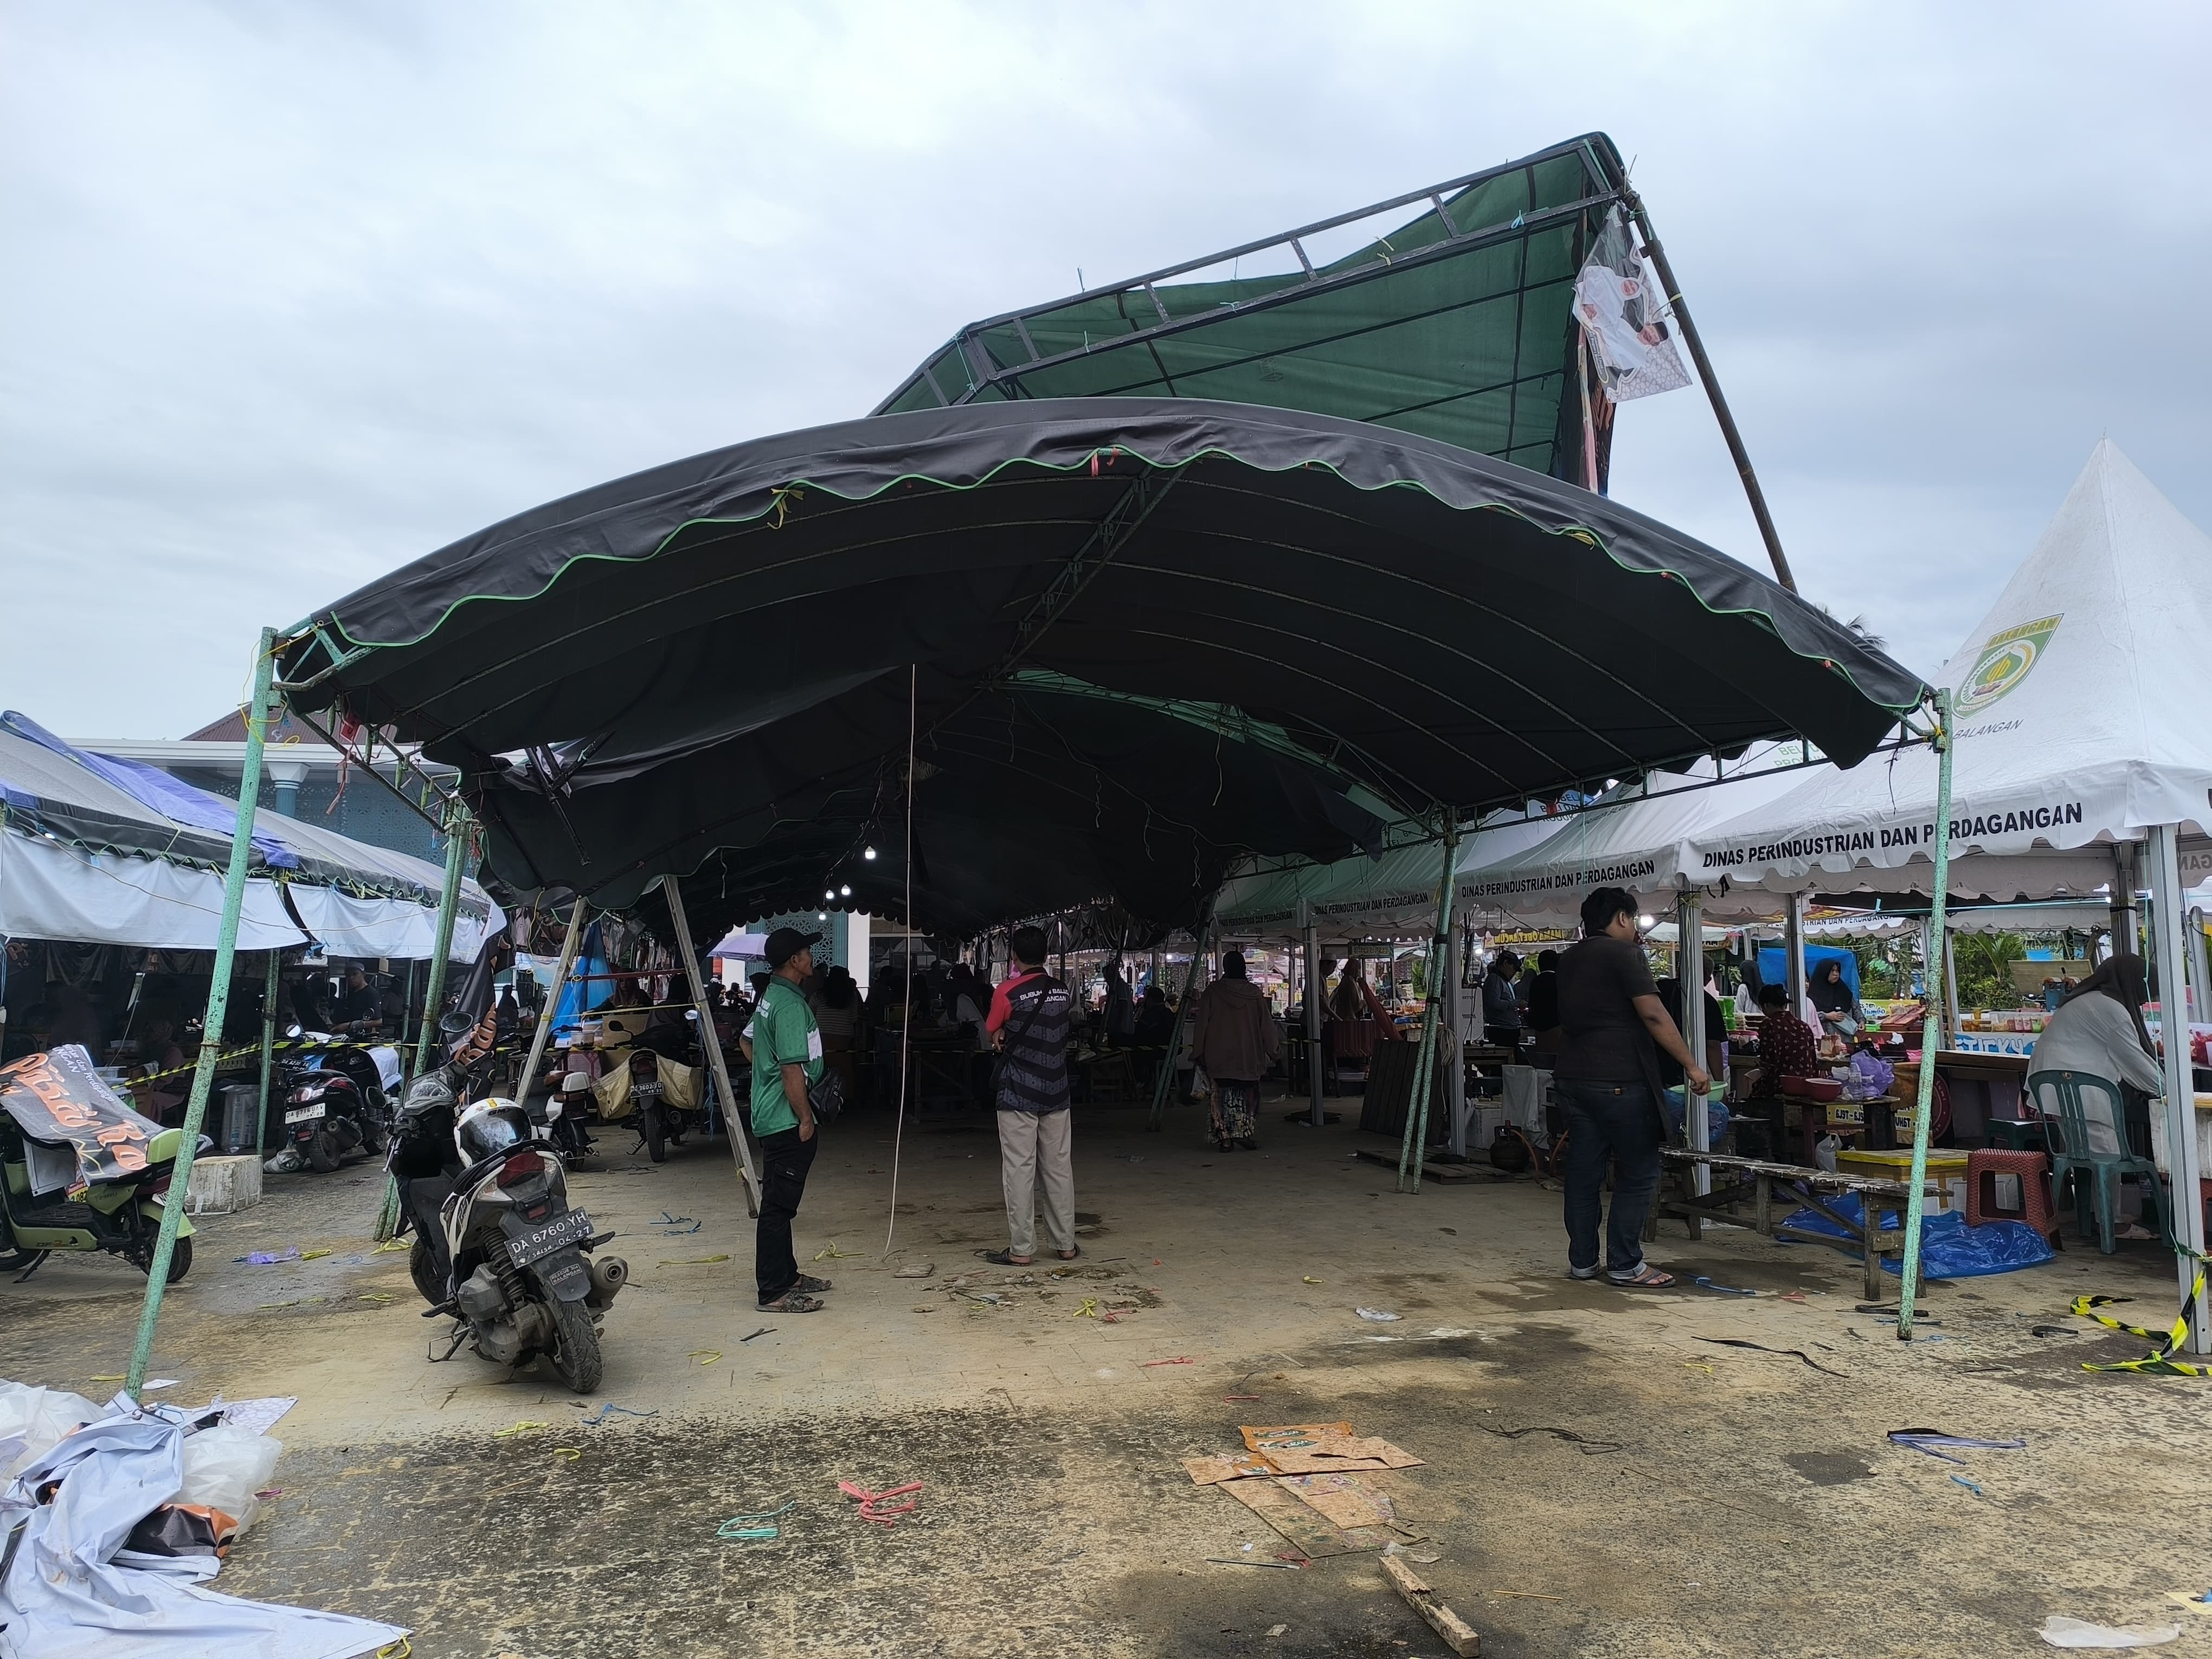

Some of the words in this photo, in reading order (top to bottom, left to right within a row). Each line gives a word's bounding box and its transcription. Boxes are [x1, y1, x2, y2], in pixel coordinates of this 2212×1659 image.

[1953, 719, 2024, 740] BALANGAN
[1703, 848, 1744, 867] DINAS
[1748, 832, 1874, 863] PERINDUSTRIAN
[1881, 826, 1917, 847] DAN
[1924, 802, 2082, 843] PRDAGANGAN
[1462, 884, 1484, 897] DINAS
[1486, 876, 1552, 895] PERINDUSTRIAN
[1554, 873, 1573, 888] DAN
[1576, 860, 1655, 885] PERDAGANGAN
[1328, 901, 1370, 914] PERINDUSTRIAN
[1371, 899, 1382, 910] DAN
[1383, 892, 1429, 909] PERDAGANGAN
[83, 1071, 115, 1102] Perdagangan
[511, 1239, 530, 1254] DA
[532, 1222, 565, 1244] 6760
[567, 1212, 587, 1226] YH
[532, 1245, 552, 1258] SALSA
[551, 1268, 570, 1279] RESCUE
[553, 1269, 581, 1283] BALANGAN
